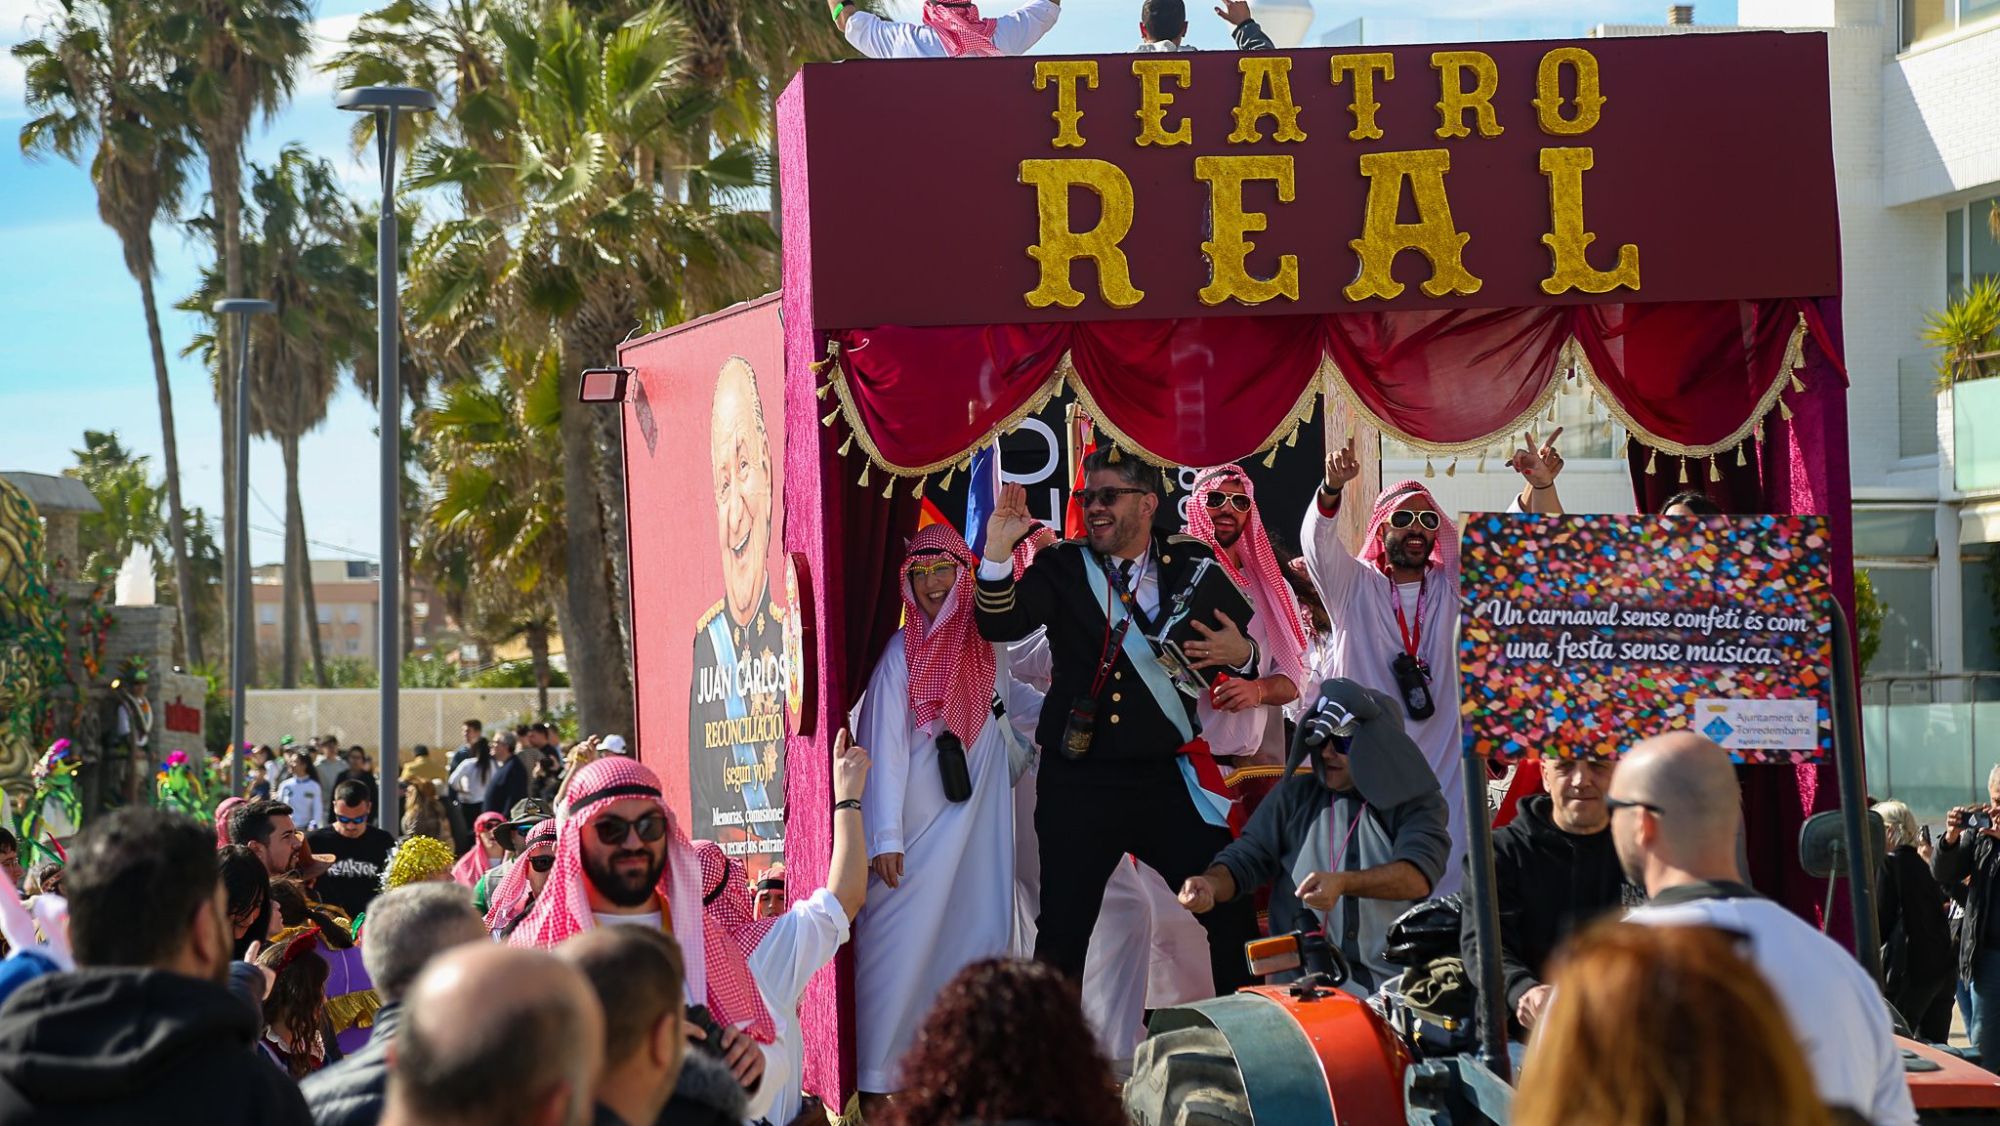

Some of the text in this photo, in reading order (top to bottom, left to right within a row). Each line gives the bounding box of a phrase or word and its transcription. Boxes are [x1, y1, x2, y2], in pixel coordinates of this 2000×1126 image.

[1034, 48, 1606, 147] TEATRO
[1019, 146, 1640, 309] REAL
[1488, 599, 1809, 636] Un carnaval sense confeti és com
[1505, 632, 1781, 667] una festa sense música.
[697, 654, 785, 704] JUAN CARLOS
[1735, 724, 1811, 735] Torredembarra
[1736, 713, 1794, 723] Ajuntament
[723, 755, 768, 793] (según yo)
